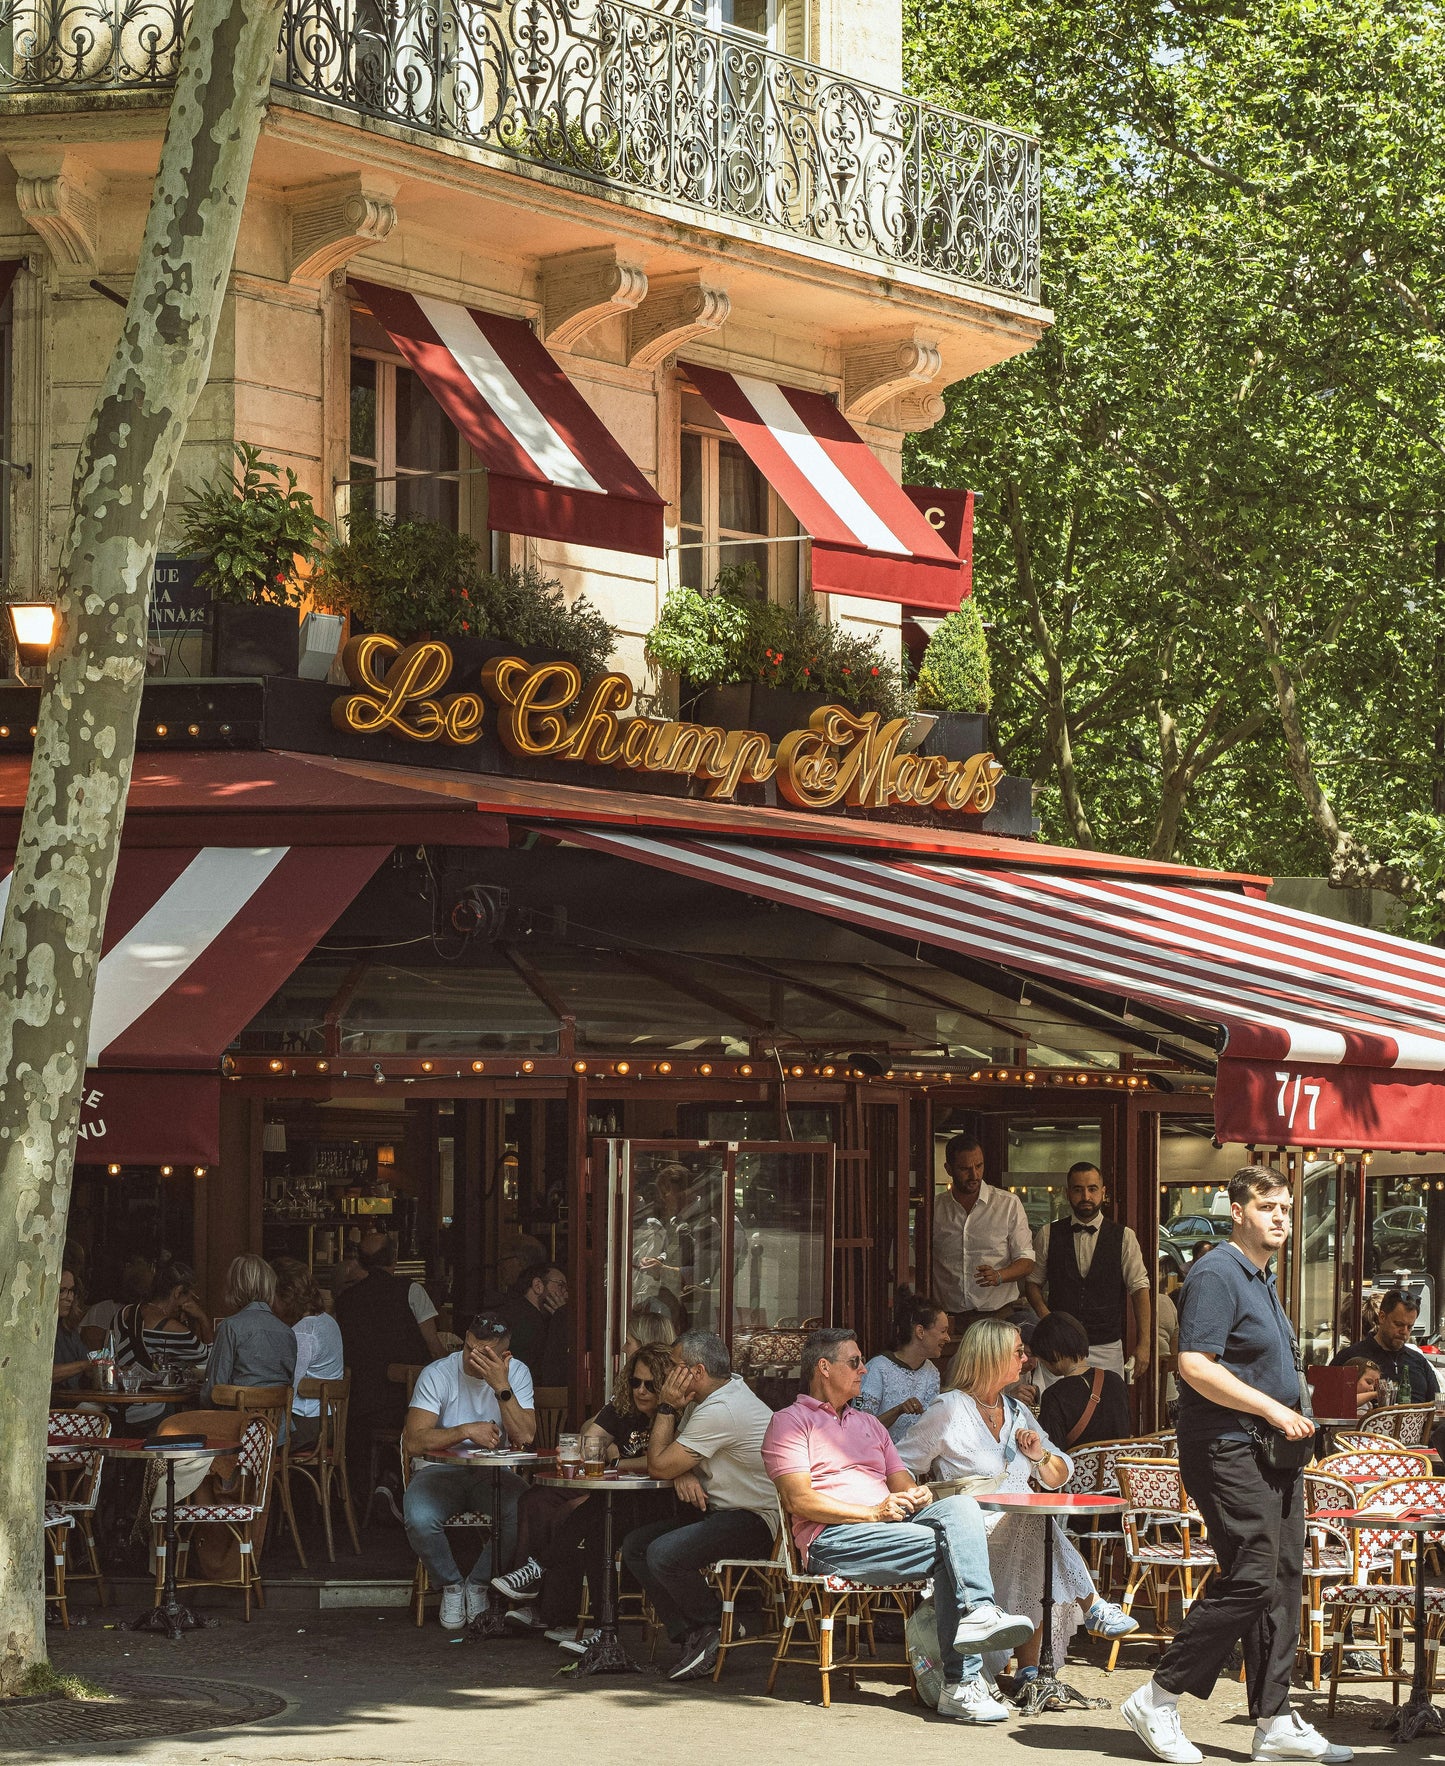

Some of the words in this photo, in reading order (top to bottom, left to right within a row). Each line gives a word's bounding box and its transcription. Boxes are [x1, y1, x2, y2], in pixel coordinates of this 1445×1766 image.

[924, 506, 946, 530] C
[155, 568, 179, 583] UE
[151, 607, 205, 623] NNAIS
[331, 632, 485, 746] Le
[481, 656, 778, 798] Champ
[775, 704, 1005, 814] Mars
[797, 742, 841, 791] de
[1275, 1071, 1321, 1131] 7/7
